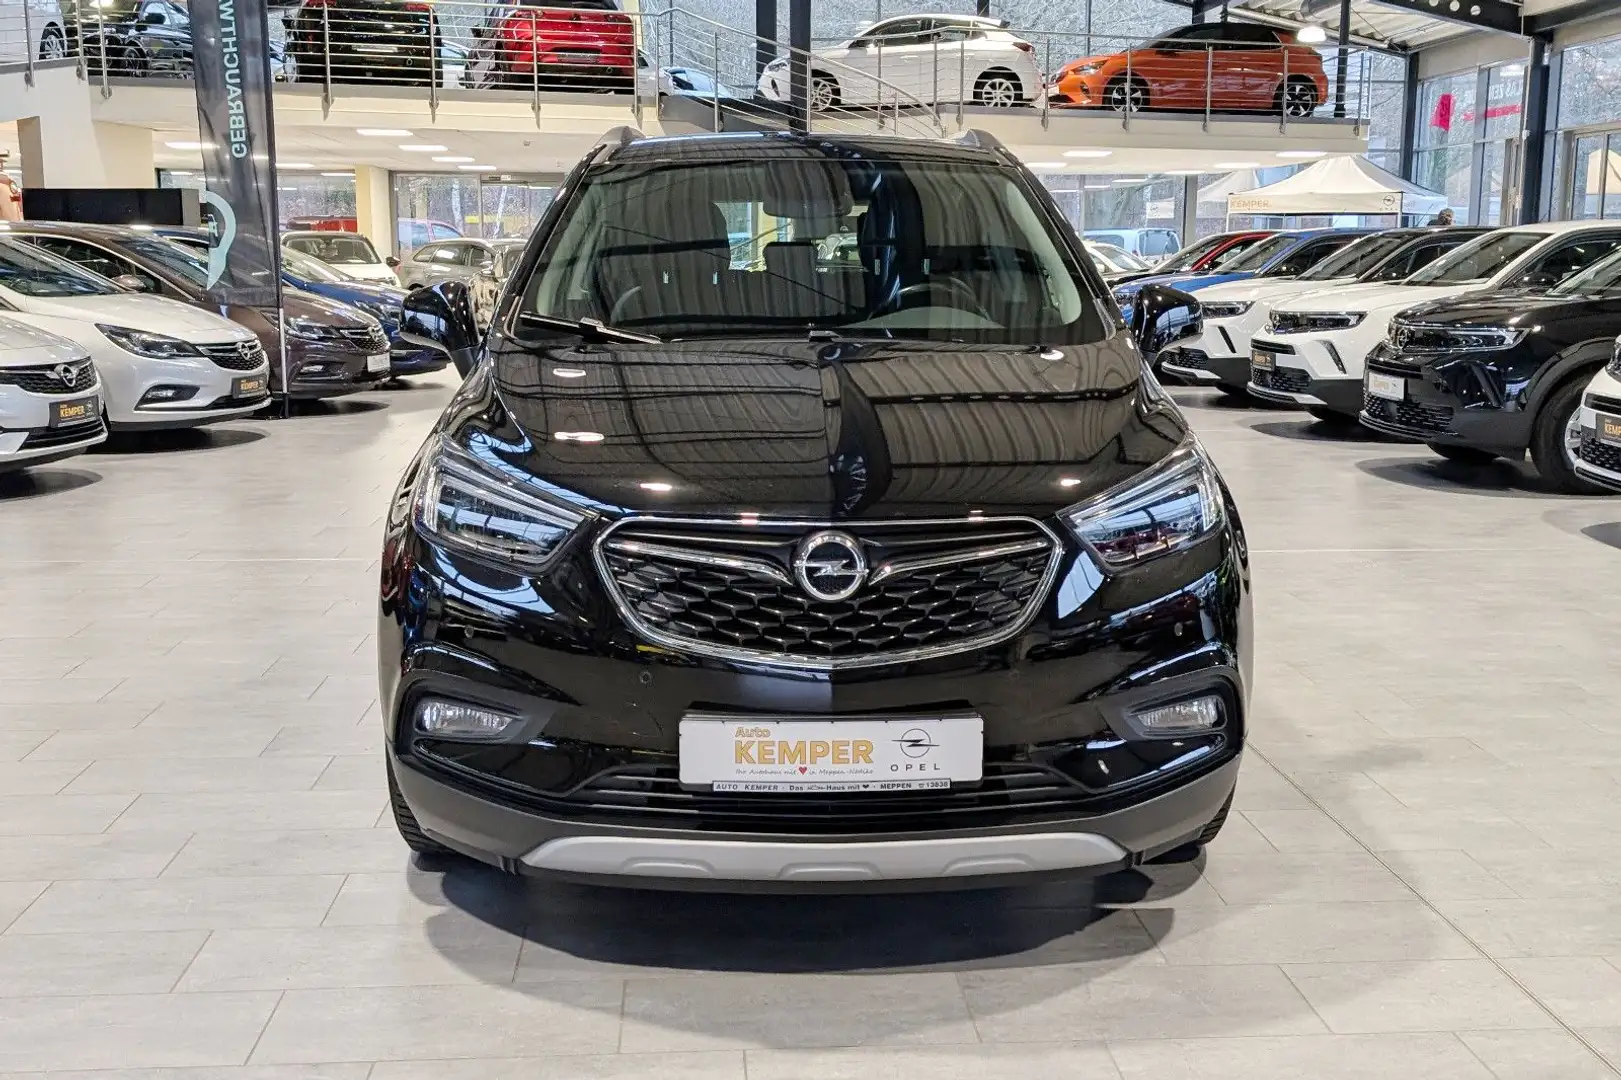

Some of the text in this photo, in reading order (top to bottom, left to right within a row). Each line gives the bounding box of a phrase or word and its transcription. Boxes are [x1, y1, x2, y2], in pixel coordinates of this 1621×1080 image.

[59, 405, 85, 418] KEMPER
[735, 726, 771, 738] Auto
[734, 739, 874, 765] KEMPER
[890, 763, 940, 772] OPEL
